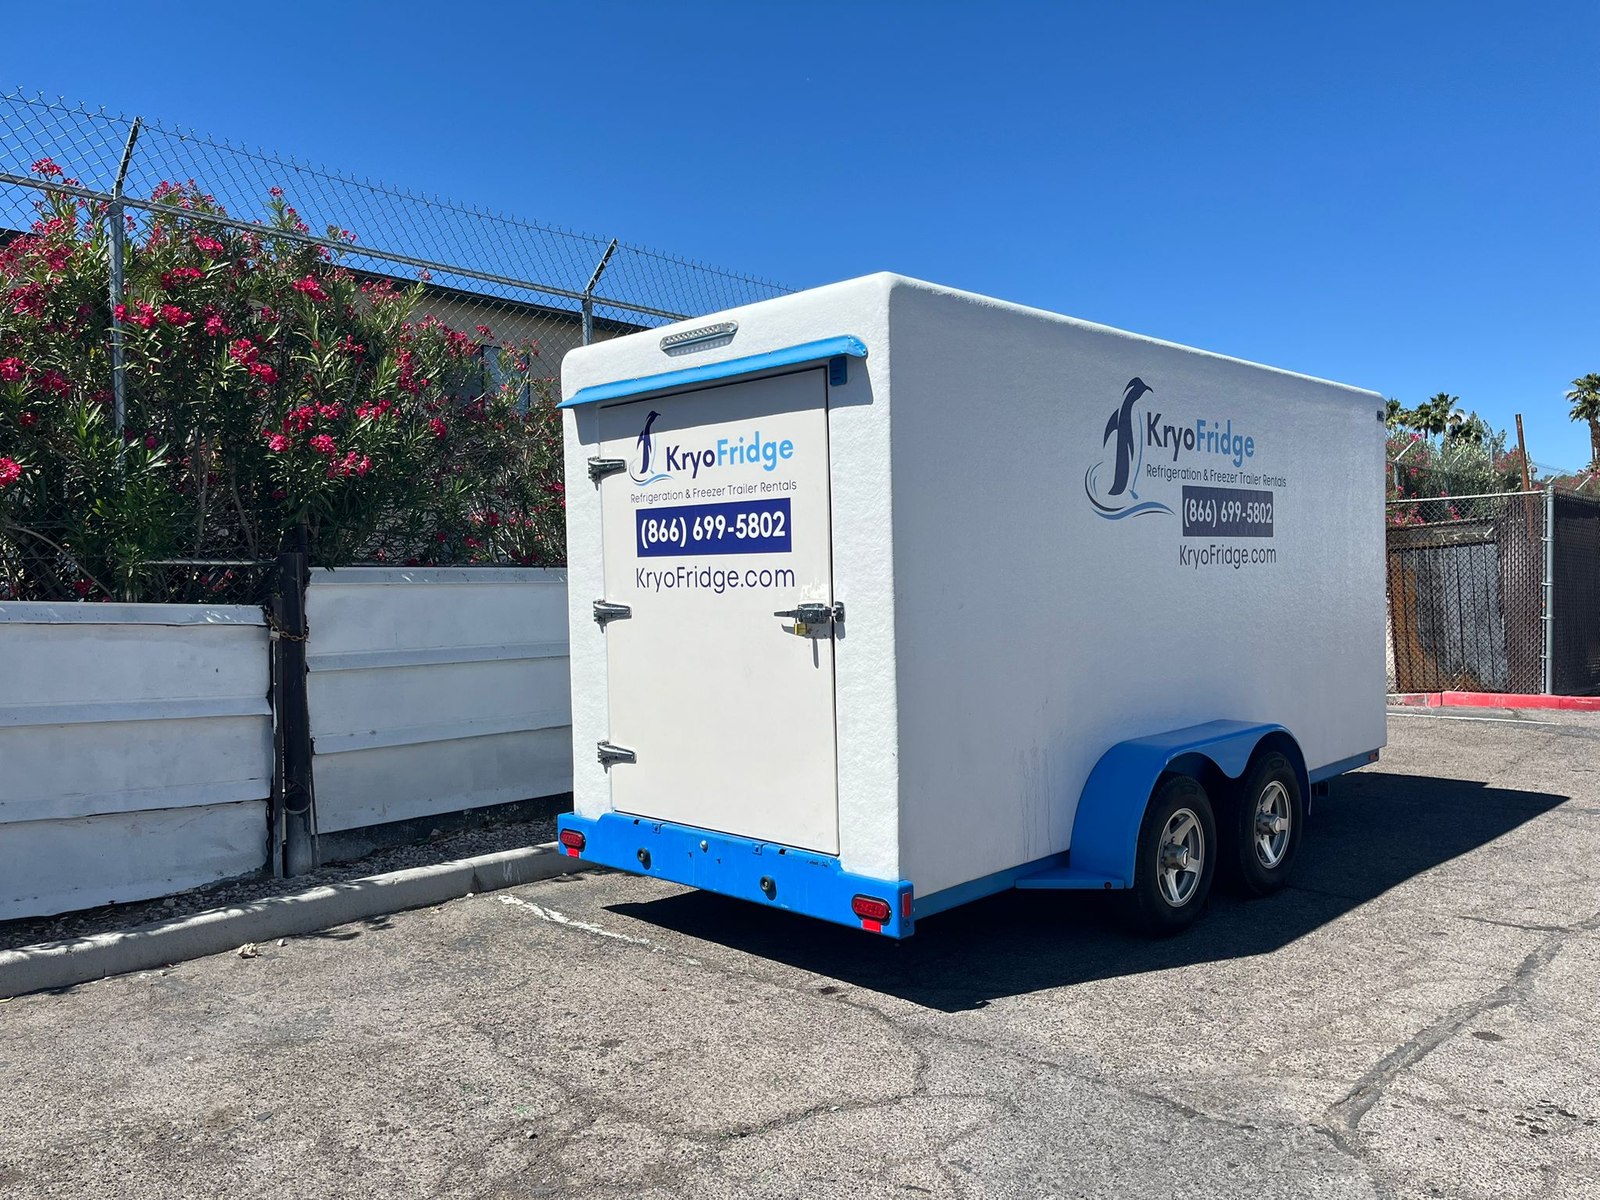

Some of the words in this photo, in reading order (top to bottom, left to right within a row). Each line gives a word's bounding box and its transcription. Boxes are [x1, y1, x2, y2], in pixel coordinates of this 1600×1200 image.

[666, 431, 794, 478] KryoFridge
[1147, 412, 1255, 468] KryoFridge
[1146, 464, 1201, 481] Refrigeration
[1203, 471, 1209, 481] &
[1210, 470, 1238, 483] Freezer
[1239, 472, 1261, 486] Trailer
[1262, 474, 1287, 487] Rentals
[630, 489, 684, 504] Refrigeration
[685, 489, 691, 499] &
[693, 487, 726, 498] Freezer
[728, 484, 758, 496] Trailer
[760, 479, 797, 493] Rentals
[1184, 498, 1217, 528] (866)
[1221, 500, 1273, 524] 699-5802
[641, 517, 687, 548] (866)
[692, 511, 786, 541] 699-5802
[1179, 544, 1277, 570] KryoFridge.com
[636, 566, 795, 594] KryoFridge.com
